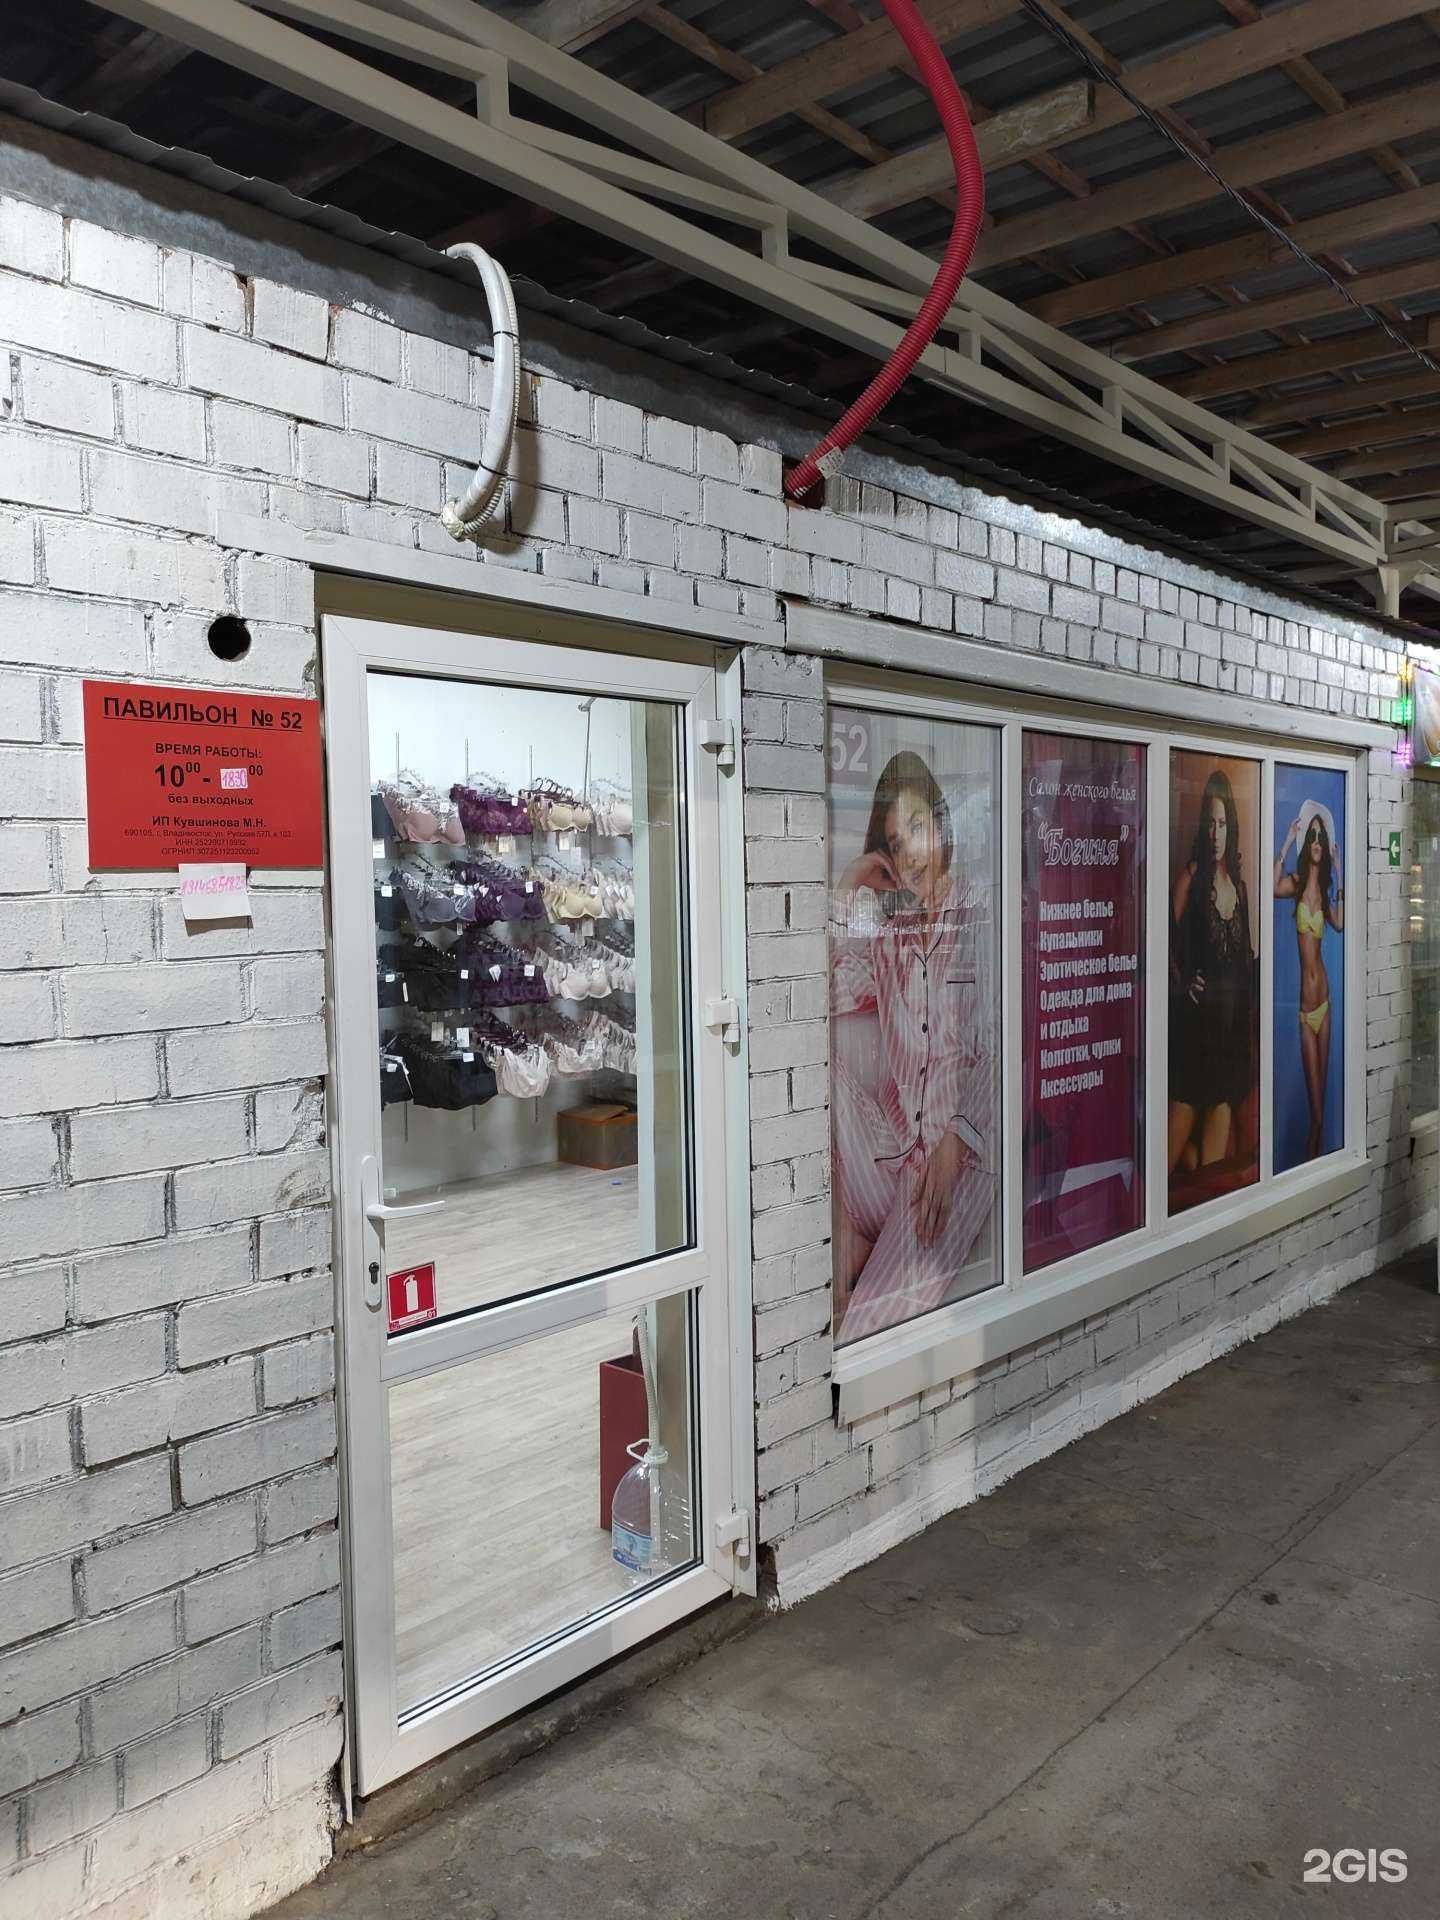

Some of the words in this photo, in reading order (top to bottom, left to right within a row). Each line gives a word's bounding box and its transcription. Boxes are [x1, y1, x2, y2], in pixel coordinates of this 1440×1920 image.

[103, 696, 237, 725] ПАВИЛЬОН
[250, 708, 274, 727] №
[280, 711, 302, 729] 52
[155, 742, 201, 756] ВРЕМЯ
[205, 746, 262, 759] РАБОТЫ:
[168, 792, 189, 804] без
[192, 795, 254, 806] выходных
[1029, 777, 1060, 797] Салон
[1063, 783, 1109, 803] женского
[1110, 780, 1137, 801] белья
[152, 816, 170, 826] ИП
[173, 816, 240, 828] Кувшинова
[1040, 901, 1082, 921] Нижнее
[1083, 899, 1114, 919] белье
[1040, 930, 1103, 953] Купальники
[1040, 957, 1107, 982] Эротическое
[1108, 953, 1137, 972] белье
[1040, 990, 1084, 1012] Одежда
[1085, 985, 1105, 1006] для
[1106, 982, 1132, 1003] дома
[1040, 1023, 1048, 1040] и
[1049, 1016, 1089, 1039] отдыха
[1092, 1038, 1121, 1060] чулки
[1040, 1069, 1104, 1099] Аксессуары
